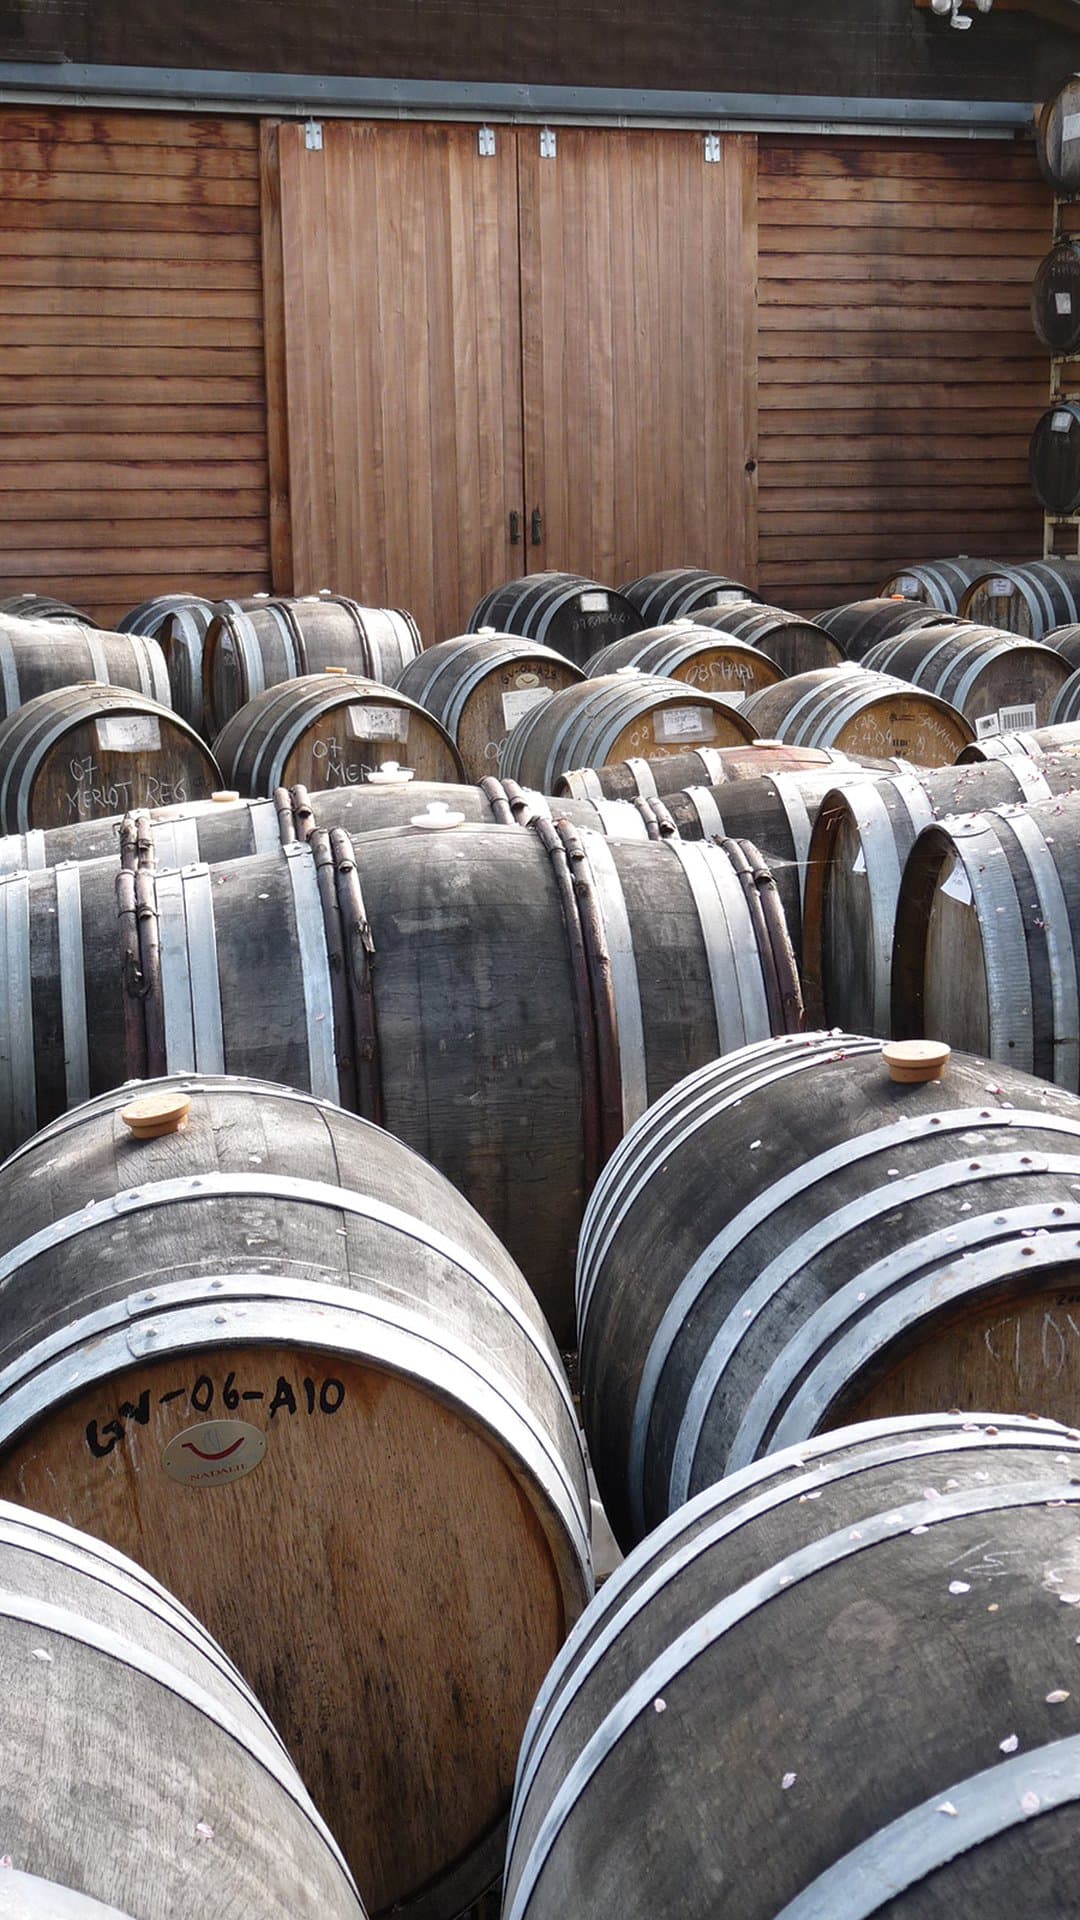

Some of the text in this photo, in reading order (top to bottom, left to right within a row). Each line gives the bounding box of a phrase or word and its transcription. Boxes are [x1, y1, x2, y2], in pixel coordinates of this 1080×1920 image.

[312, 736, 343, 759] 07
[629, 725, 649, 746] 08
[70, 756, 98, 785] 07
[65, 780, 133, 816] MERLOT
